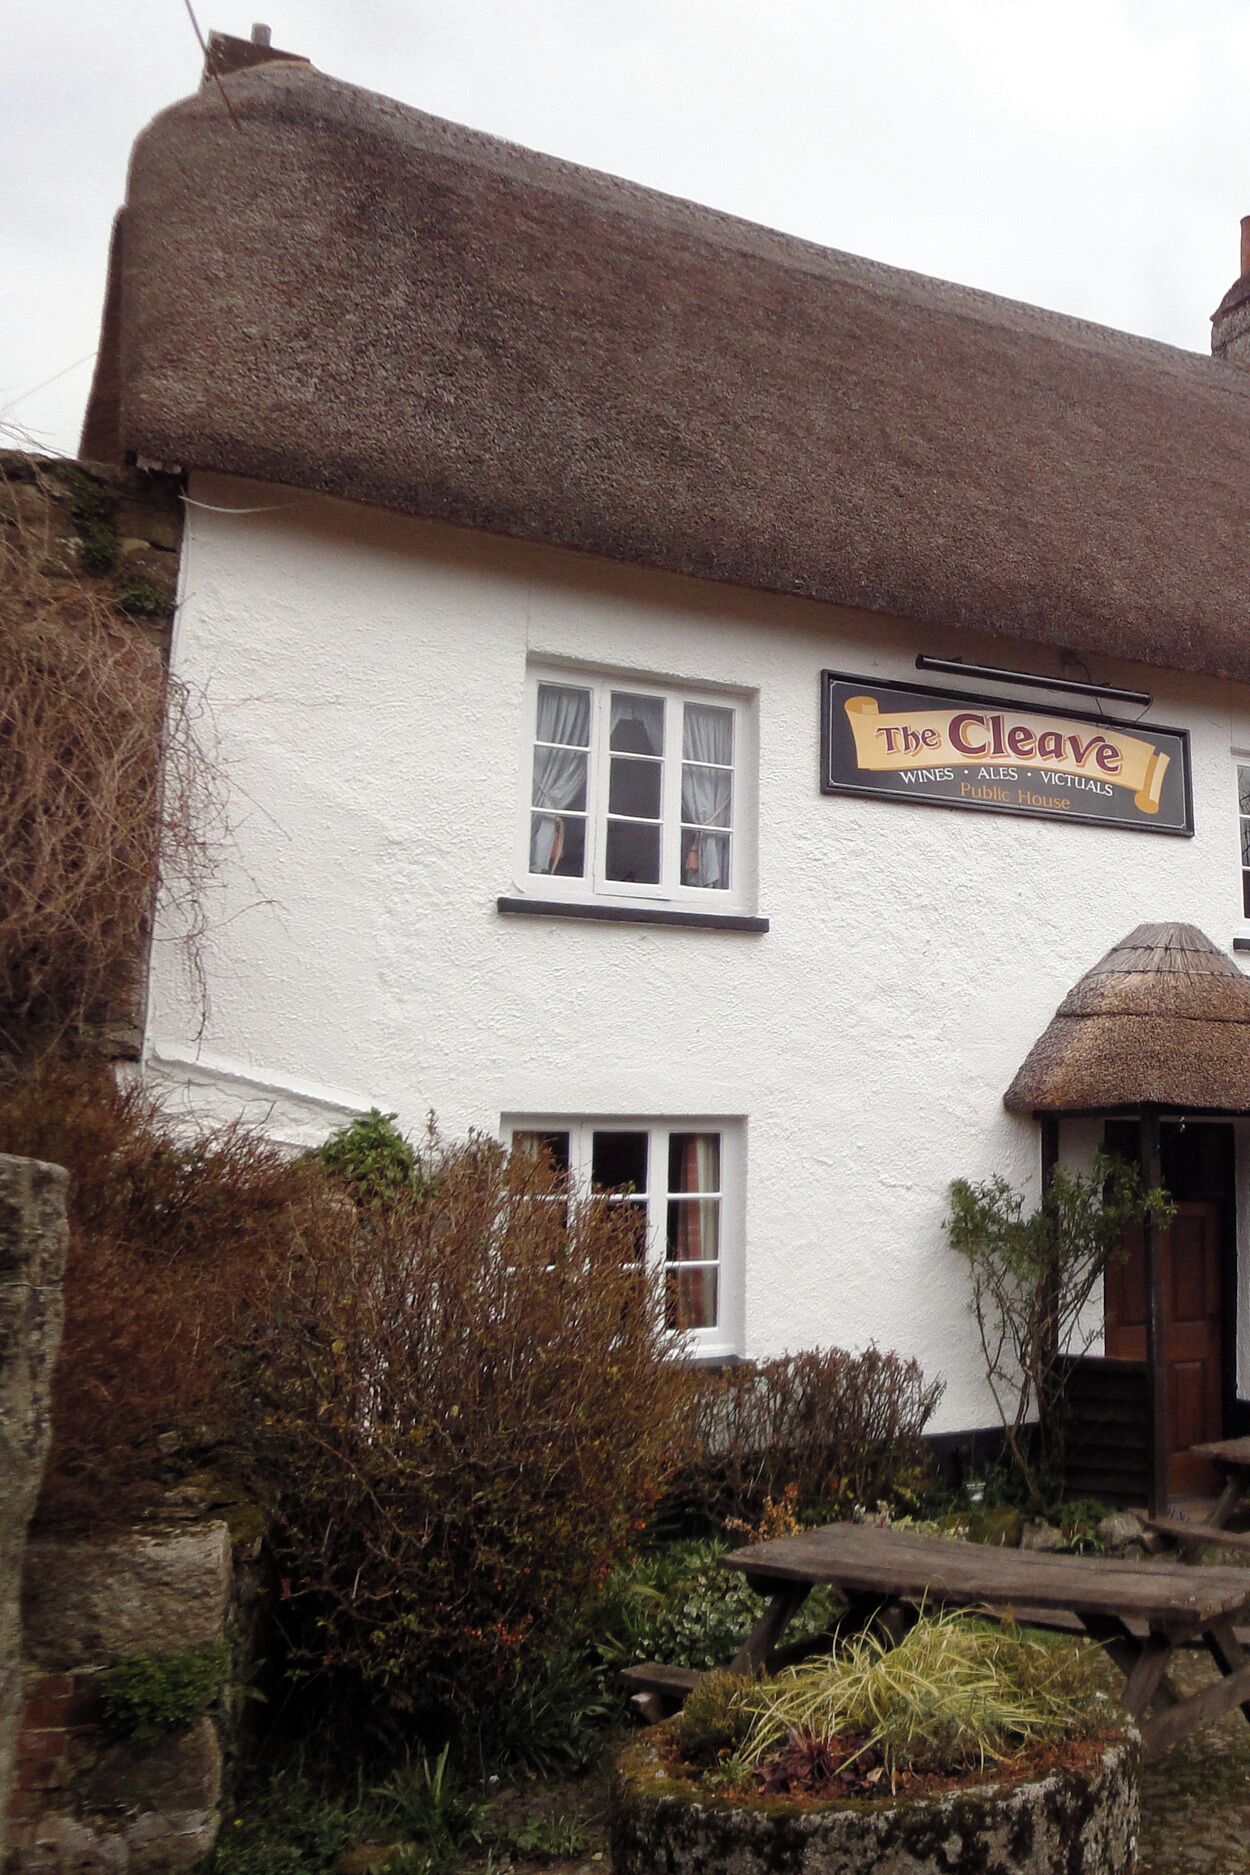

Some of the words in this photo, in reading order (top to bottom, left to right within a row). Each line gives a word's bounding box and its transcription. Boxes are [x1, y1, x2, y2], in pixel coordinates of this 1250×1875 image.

[875, 726, 942, 756] The
[948, 713, 1122, 775] Cleave
[900, 767, 954, 784] WINES
[977, 766, 1018, 780] ALES
[1040, 770, 1114, 797] VICTUALS
[960, 781, 1010, 801] Public
[1018, 789, 1071, 809] House
